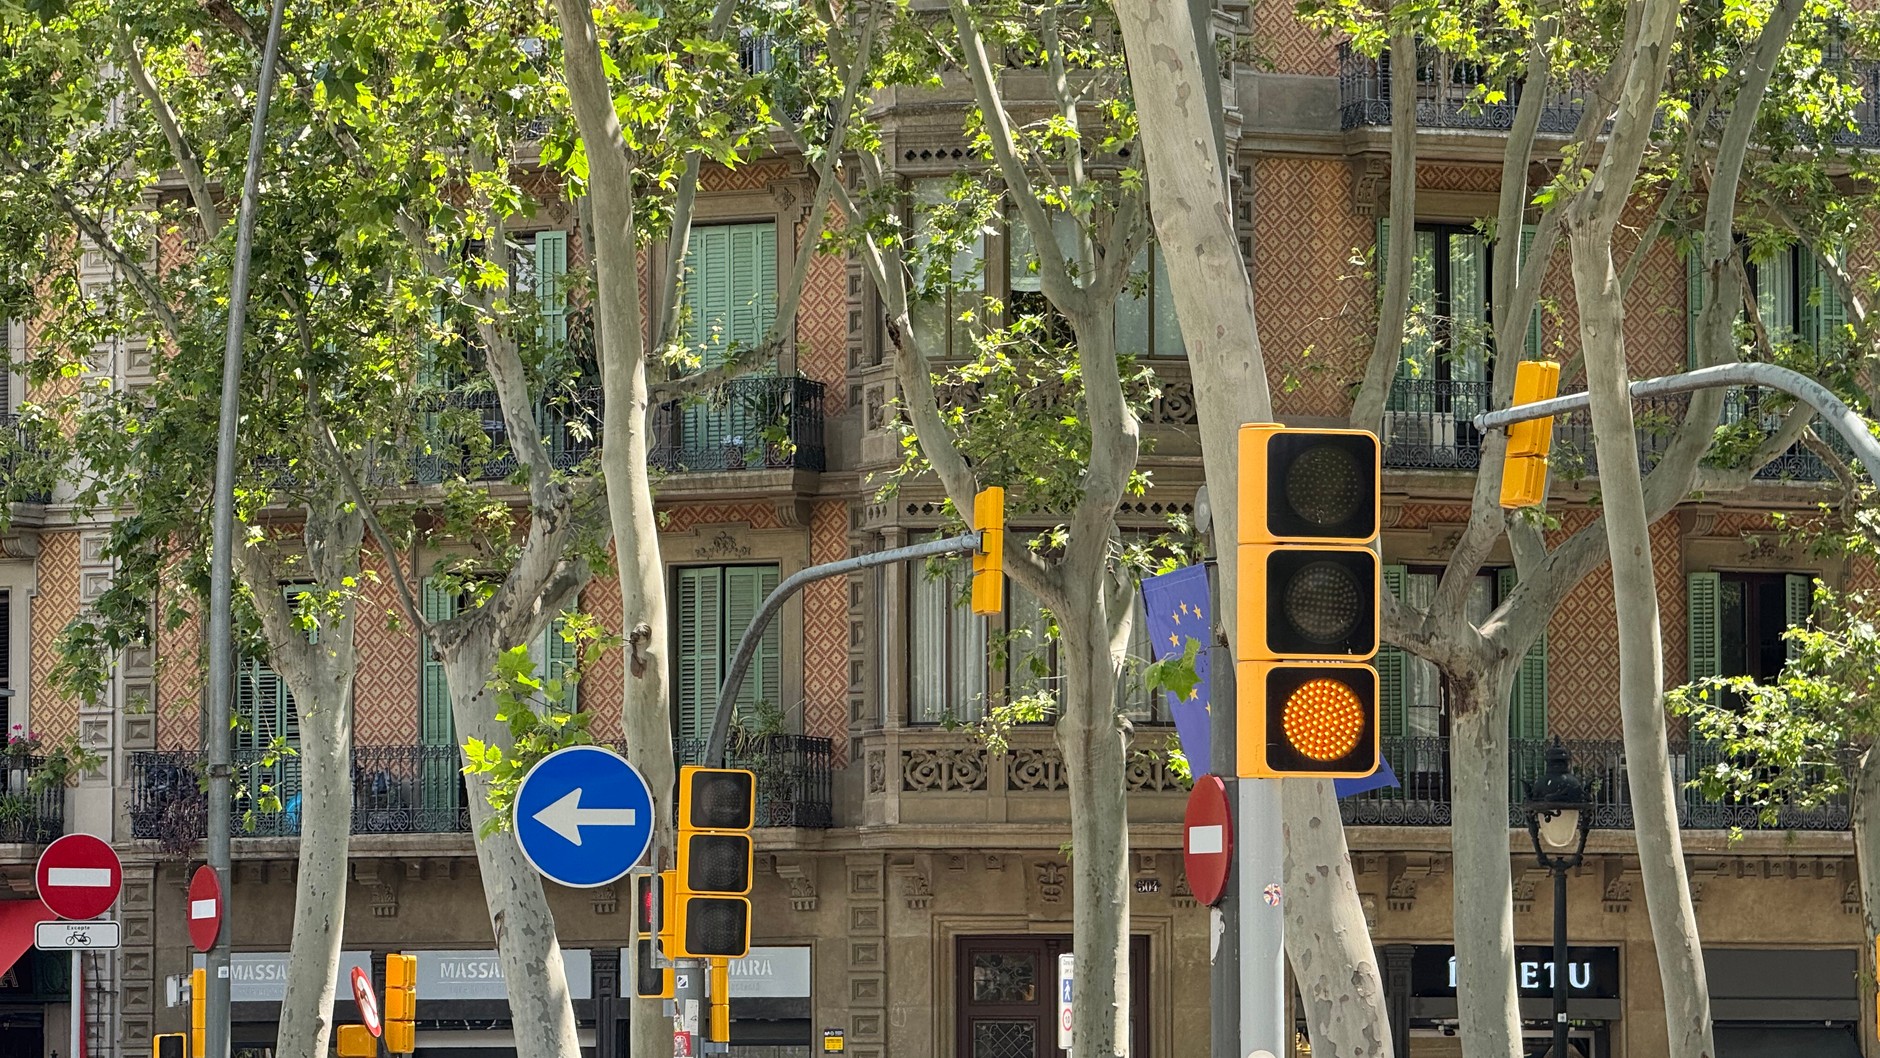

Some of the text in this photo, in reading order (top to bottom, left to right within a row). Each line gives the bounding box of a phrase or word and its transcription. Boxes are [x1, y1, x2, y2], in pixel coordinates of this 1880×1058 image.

[1138, 880, 1158, 892] 504
[440, 962, 505, 978] MASSA
[1448, 955, 1590, 988] ÍETU
